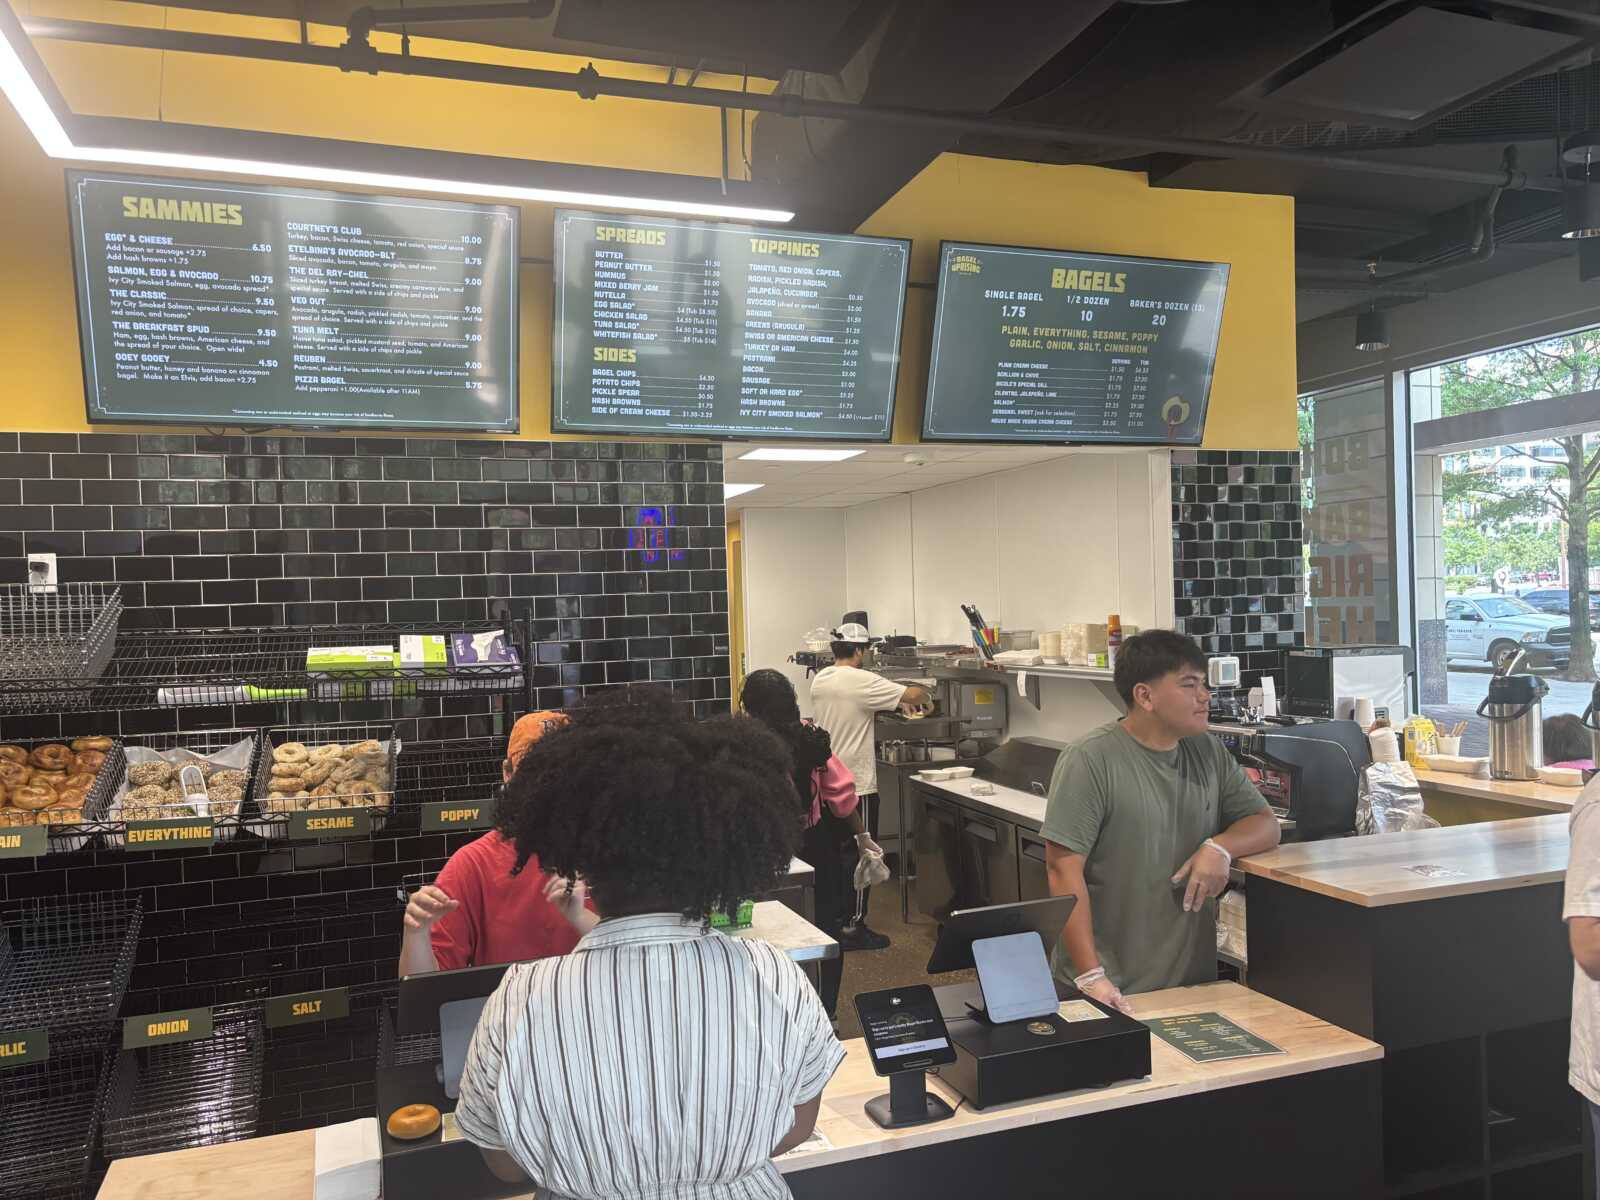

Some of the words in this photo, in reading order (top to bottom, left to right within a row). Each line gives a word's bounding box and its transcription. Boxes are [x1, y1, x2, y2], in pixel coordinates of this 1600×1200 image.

[122, 196, 242, 225] SAMMIES
[287, 222, 338, 234] COURTNEY'S
[341, 226, 361, 235] CLUB
[596, 225, 665, 245] SPREADS
[138, 234, 172, 245] CHEESE
[252, 243, 271, 252] 6.50
[749, 240, 819, 257] TOPPINGS
[955, 254, 976, 264] BAGEL
[107, 265, 146, 276] SALMON,
[179, 269, 218, 280] AVOCADO
[251, 274, 272, 284] 10.75
[290, 266, 305, 275] THE
[308, 268, 322, 276] DEL
[465, 278, 481, 286] 9.00
[1051, 269, 1126, 293] BAGELS
[110, 288, 127, 297] THE
[130, 289, 166, 299] CLASSIC
[256, 297, 274, 306] 9.50
[309, 297, 324, 305] OUT
[984, 289, 1014, 300] SINGLE
[1017, 291, 1042, 302] BAGEL
[1067, 294, 1080, 304] 1/2
[1083, 296, 1109, 306] DOZEN
[1002, 305, 1025, 318] 1.75
[1129, 299, 1161, 310] BAKER'S
[1164, 302, 1188, 311] DOZEN
[1081, 310, 1092, 322] 10
[1152, 315, 1166, 326] 20
[112, 320, 129, 330] THE
[133, 322, 183, 332] BREAKFAST
[186, 324, 209, 333] SPUD
[257, 328, 276, 337] 9.50
[292, 325, 314, 333] TUNA
[316, 326, 338, 335] MELT
[1131, 332, 1157, 343] POPPY
[594, 347, 636, 362] SIDES
[1104, 343, 1147, 355] CINNAMON
[115, 352, 138, 361] OOEY
[141, 354, 169, 362] GOOEY
[259, 359, 277, 367] 4.50
[293, 354, 325, 363] REUBEN
[440, 809, 480, 822] POPPY
[306, 816, 354, 831] SESAME
[127, 826, 212, 843] EVERYTHING
[292, 1000, 322, 1016] SALT
[147, 1019, 189, 1037] ONION
